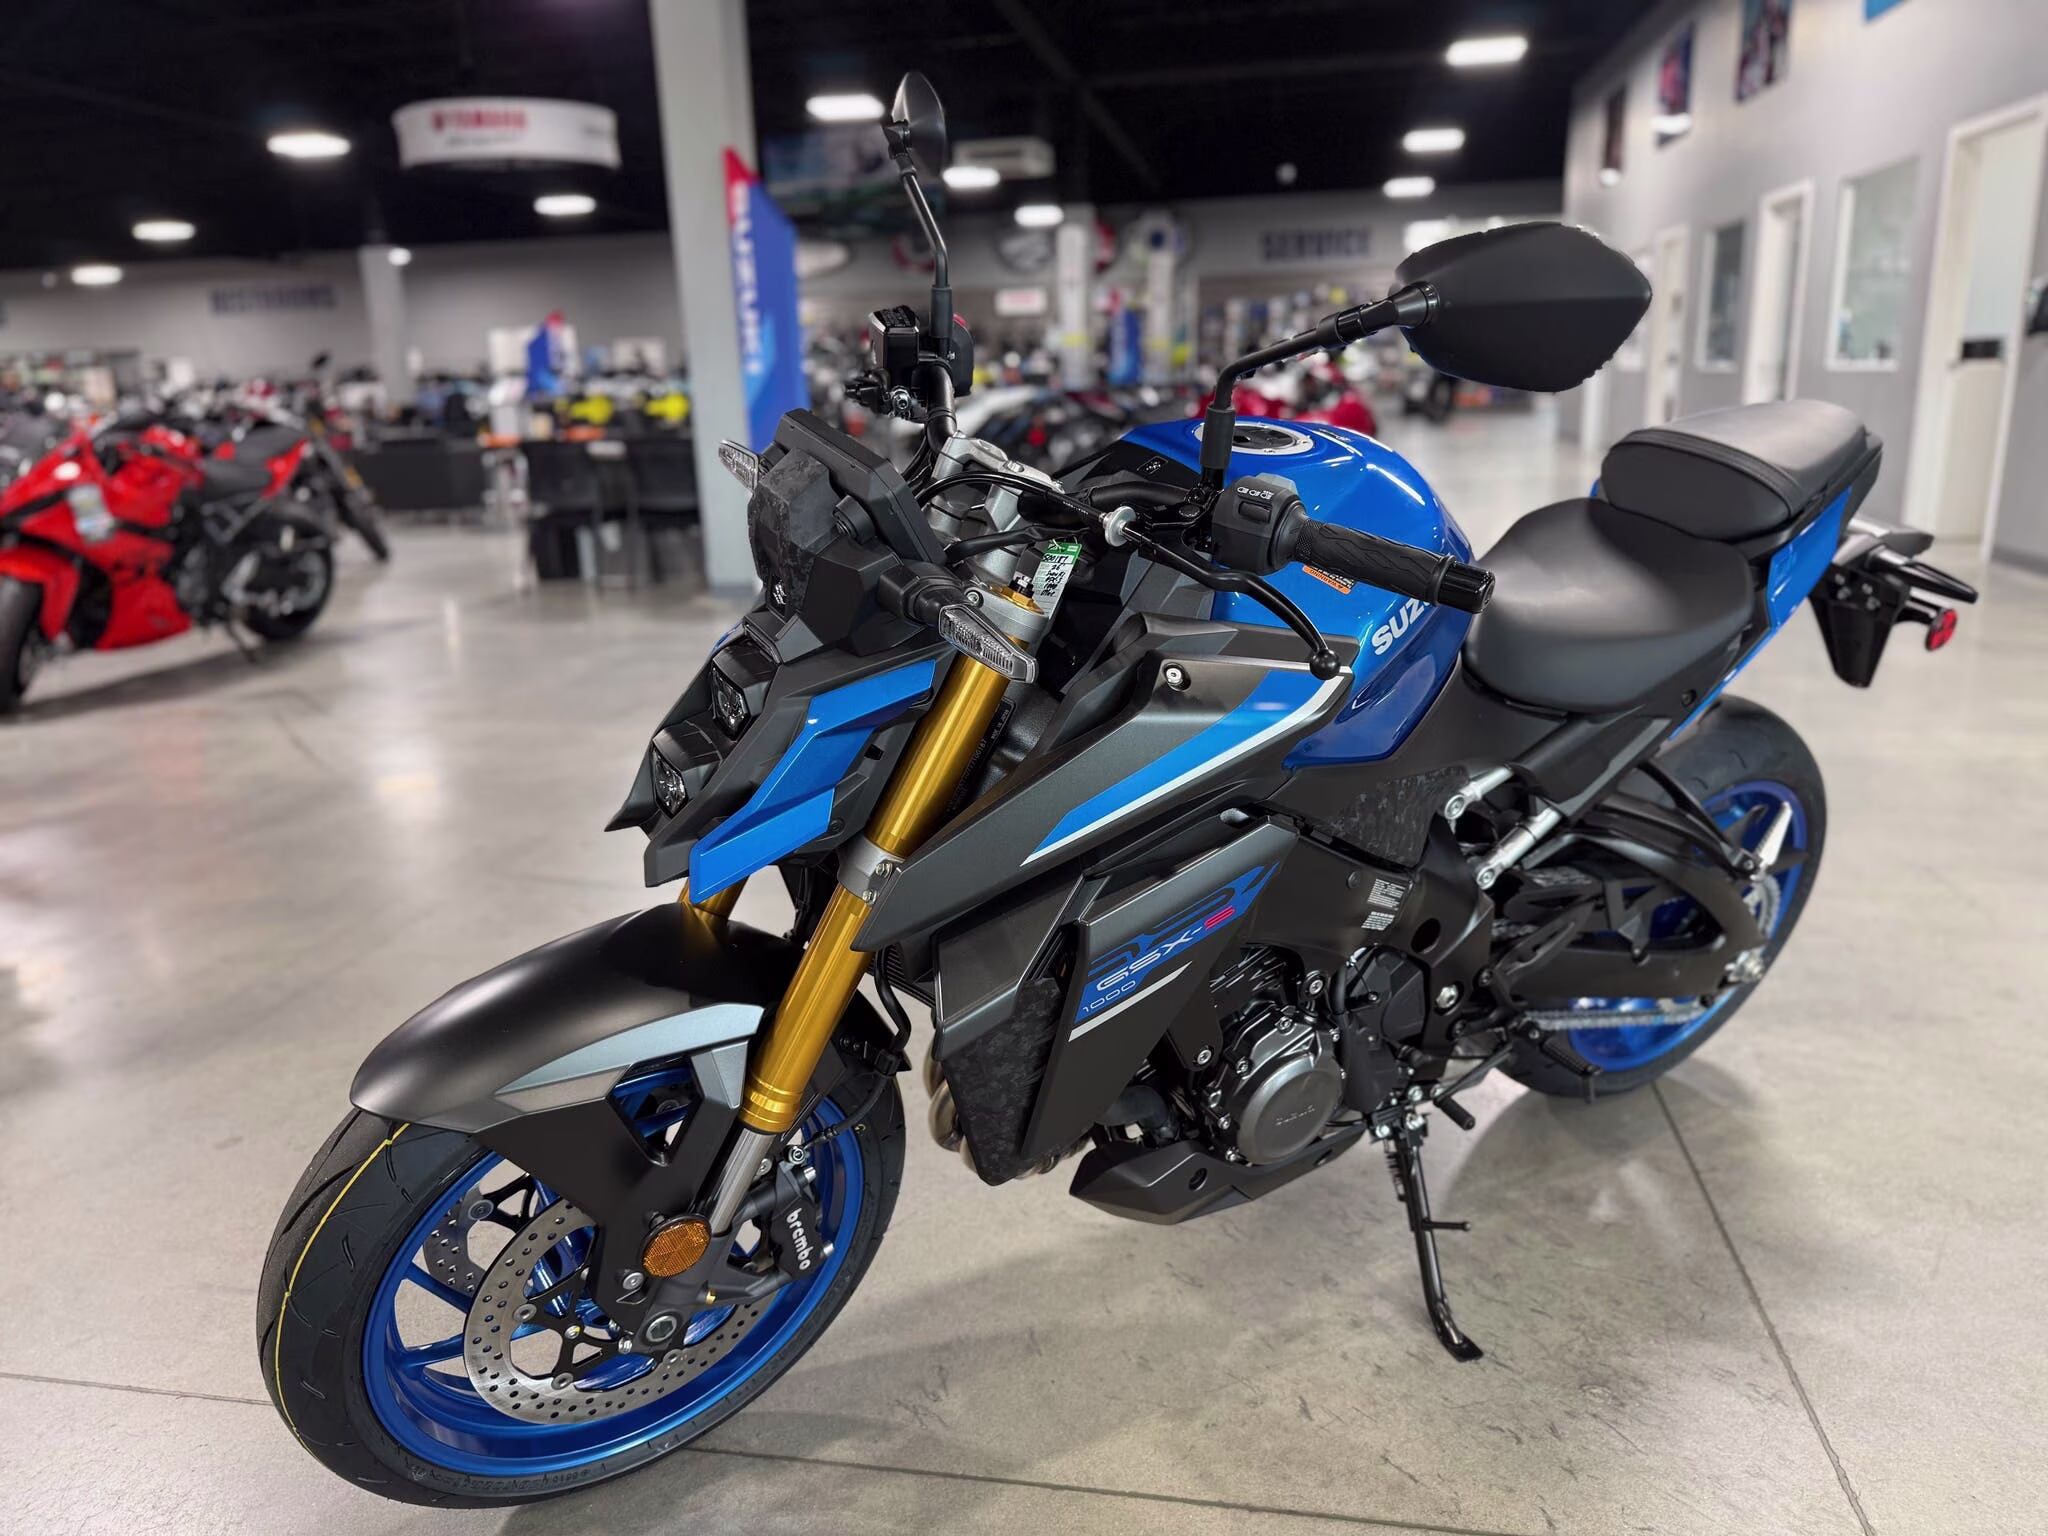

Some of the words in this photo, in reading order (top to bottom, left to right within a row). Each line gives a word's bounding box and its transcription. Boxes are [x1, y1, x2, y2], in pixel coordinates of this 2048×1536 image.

[1372, 597, 1431, 656] SUZ
[1096, 905, 1235, 991] GSX-S
[1083, 980, 1136, 1012] 1000
[786, 1207, 814, 1270] brembo
